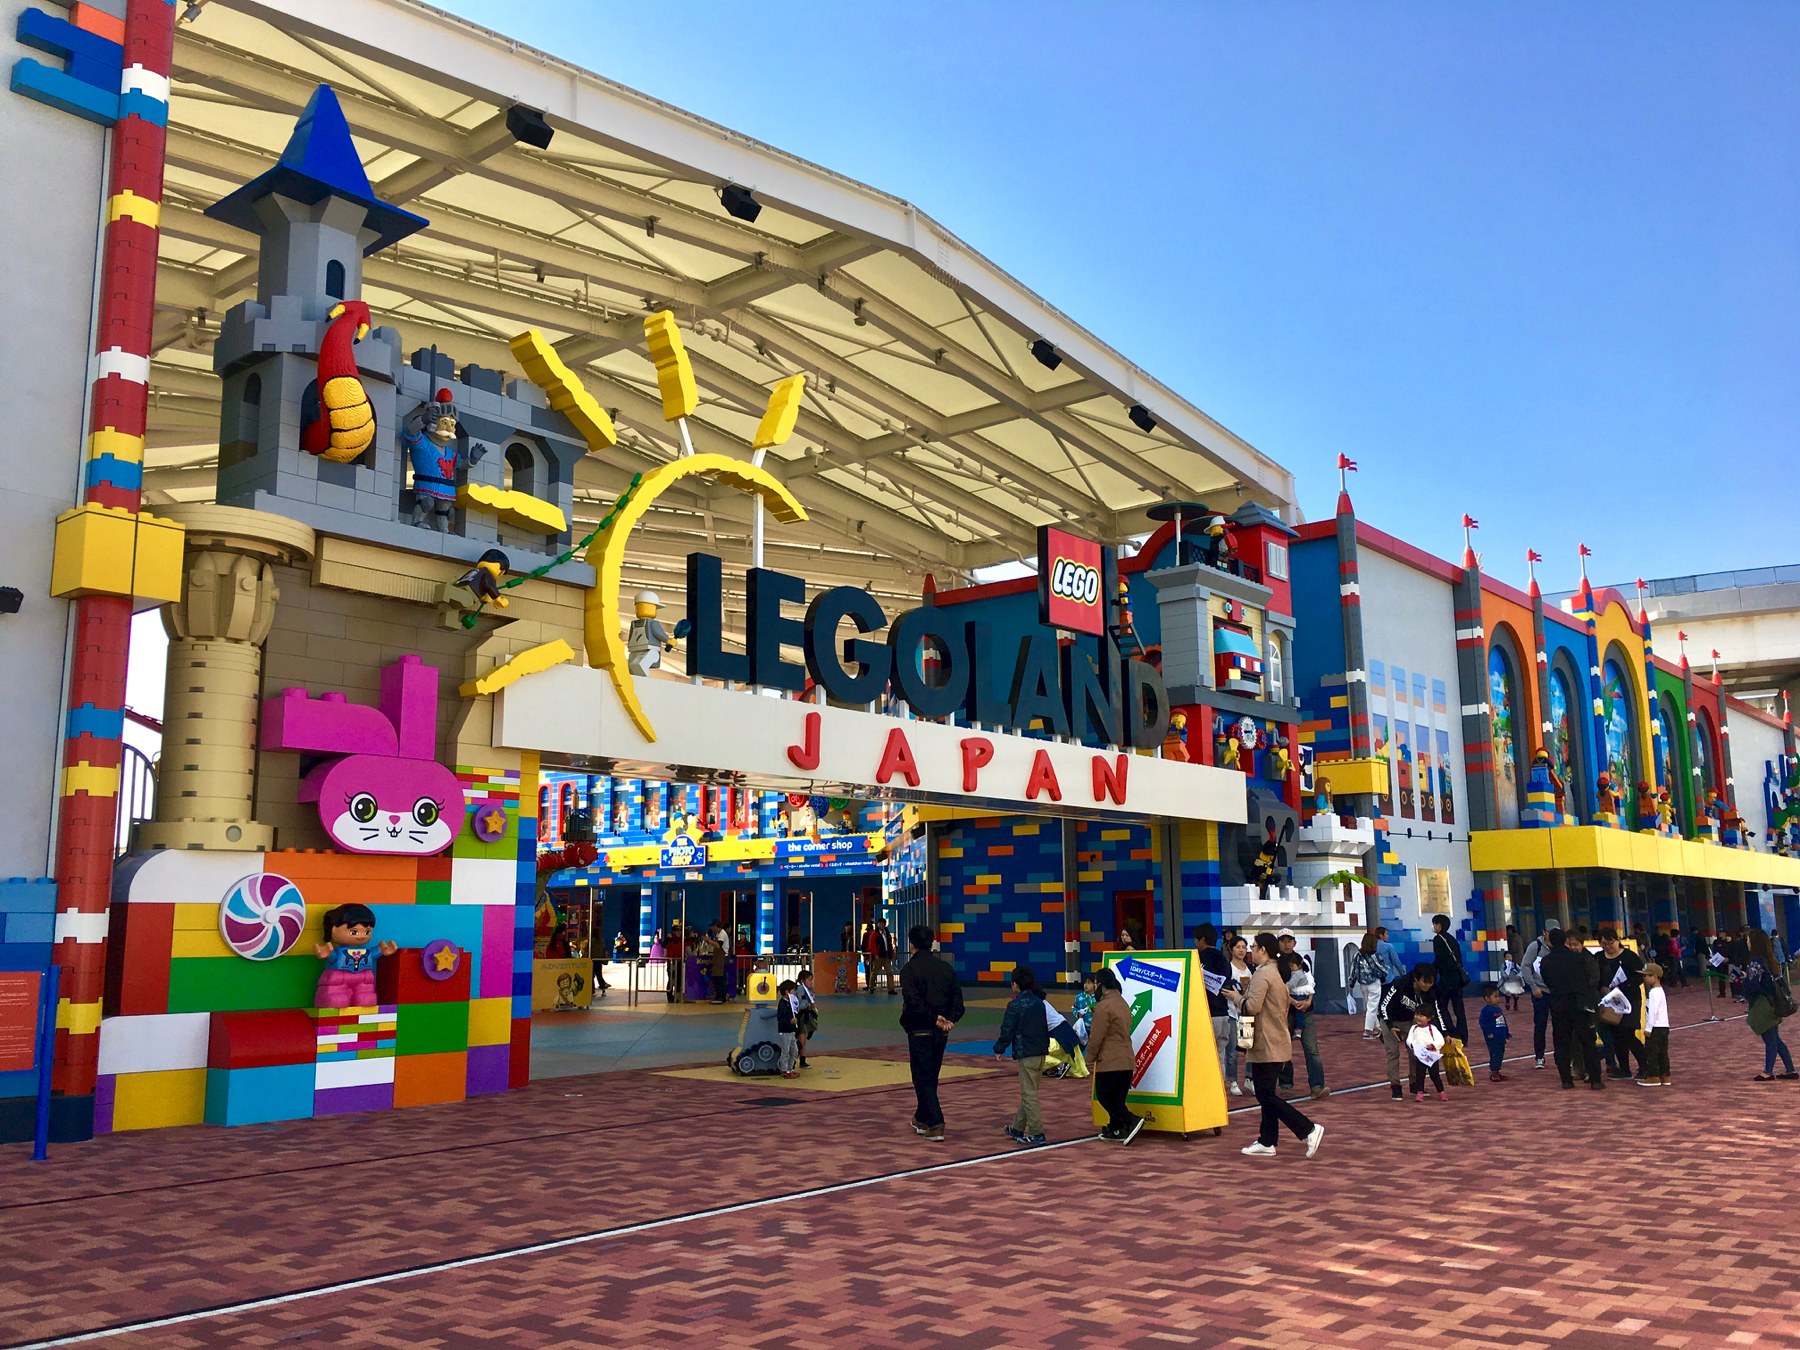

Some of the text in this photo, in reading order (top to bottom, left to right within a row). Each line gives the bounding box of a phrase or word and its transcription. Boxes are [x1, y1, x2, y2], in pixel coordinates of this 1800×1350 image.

[1052, 557, 1099, 605] LEGO
[686, 552, 1169, 750] LEGOLAND
[787, 712, 1129, 806] JAPAN
[668, 845, 696, 857] PHOTO
[787, 839, 853, 852] the corner shop
[671, 855, 693, 866] SHOP
[541, 962, 588, 970] ADVENTURE
